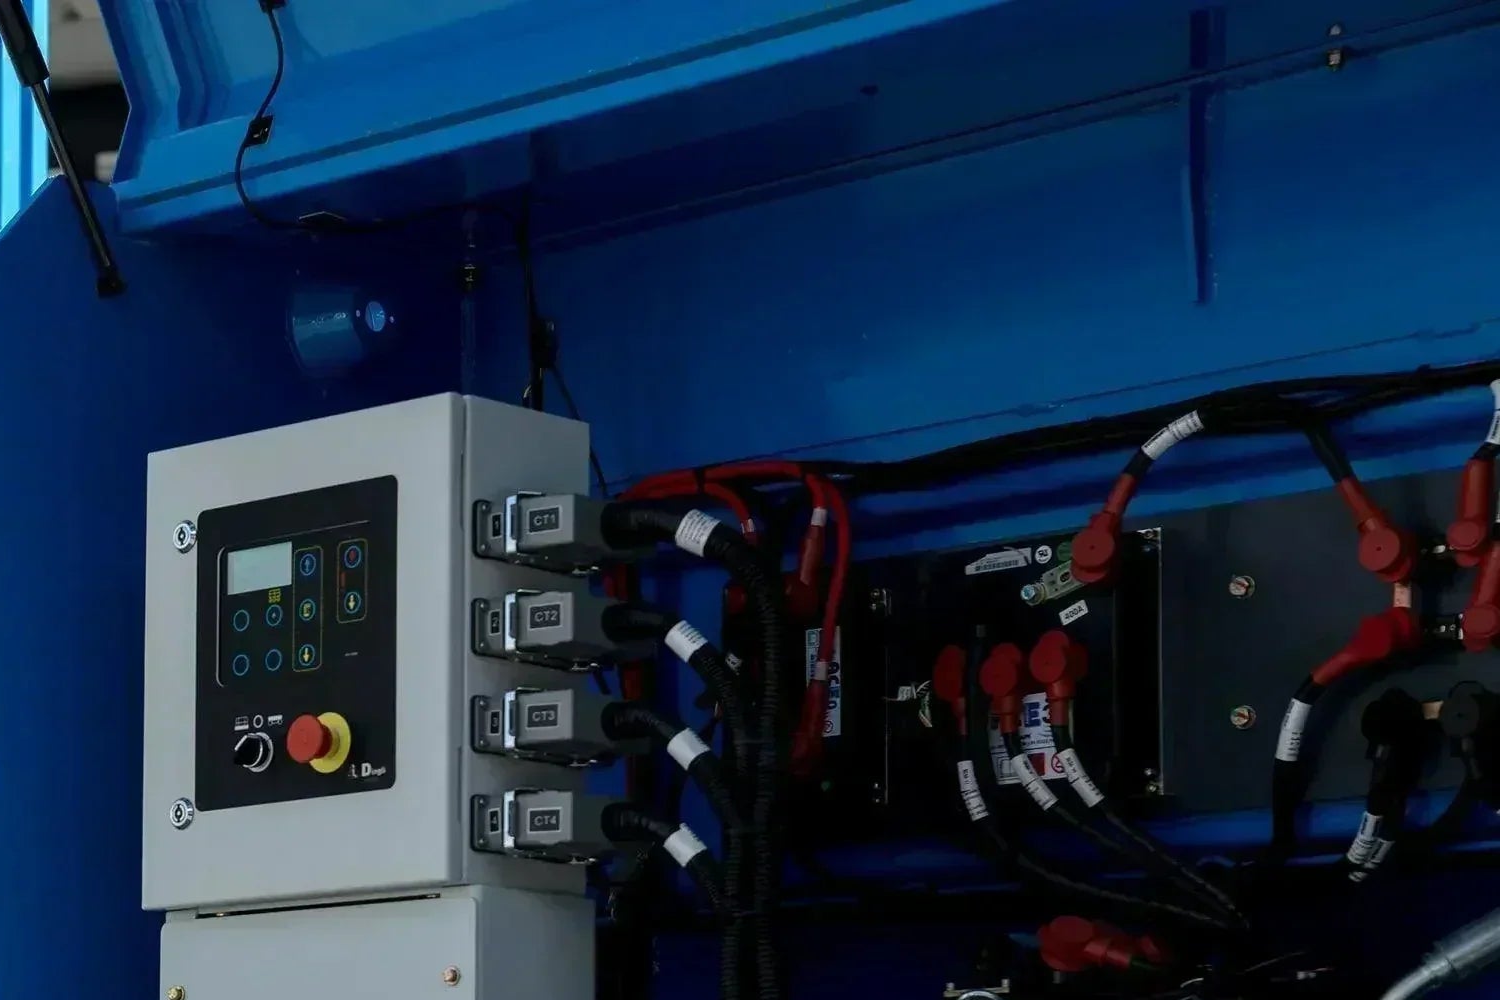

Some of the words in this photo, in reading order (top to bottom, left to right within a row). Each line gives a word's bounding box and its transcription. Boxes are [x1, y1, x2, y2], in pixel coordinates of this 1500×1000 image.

[533, 513, 556, 527] CT1
[534, 608, 558, 623] CT2
[1064, 604, 1085, 621] 400A
[532, 709, 556, 723] CT3
[533, 814, 557, 827] CT4
